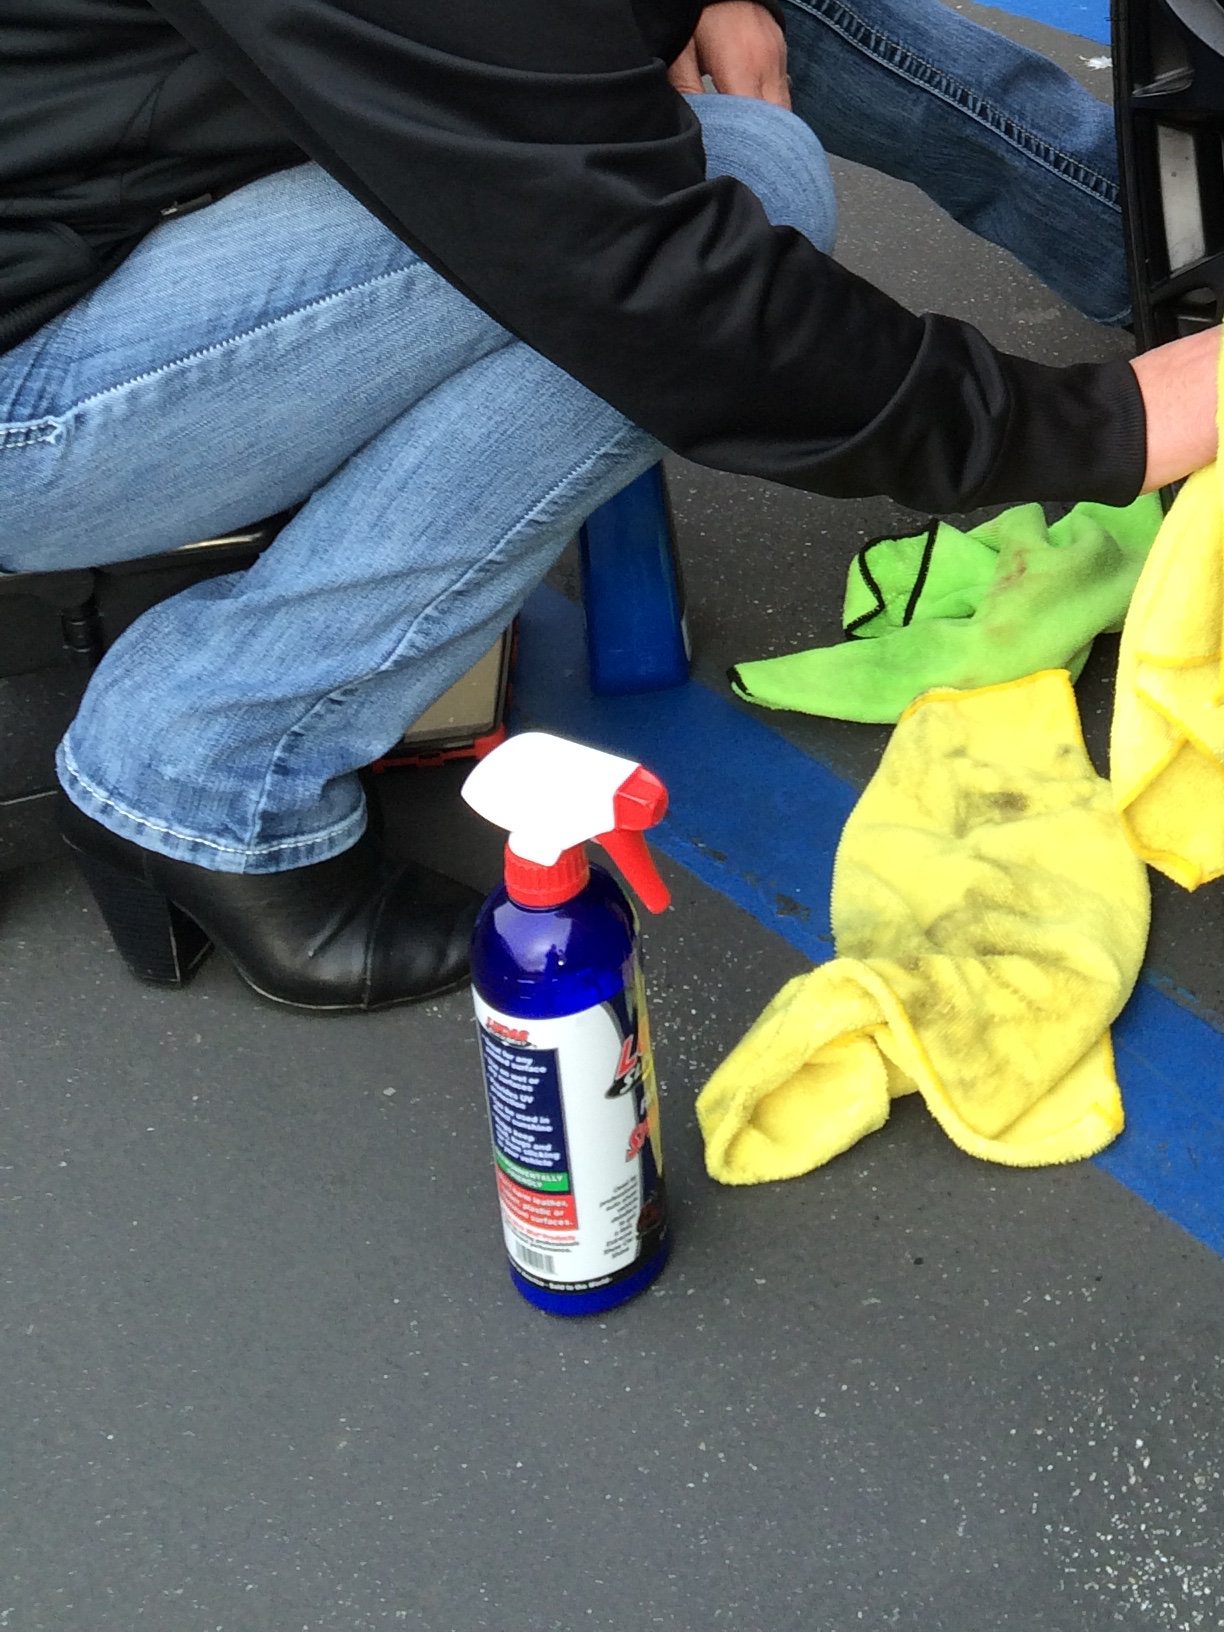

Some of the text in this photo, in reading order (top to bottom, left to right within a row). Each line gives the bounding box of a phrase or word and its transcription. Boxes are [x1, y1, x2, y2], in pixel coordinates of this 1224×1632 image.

[502, 1050, 515, 1061] for
[515, 1056, 534, 1066] any
[511, 1062, 547, 1073] surface
[498, 1074, 534, 1092] surfaces
[510, 1074, 527, 1083] wet
[528, 1077, 540, 1085] or
[519, 1094, 535, 1104] UV
[504, 1106, 515, 1117] be
[515, 1113, 538, 1123] used
[539, 1116, 551, 1124] in
[511, 1119, 554, 1132] sunshine
[513, 1129, 536, 1142] keep
[511, 1136, 532, 1148] bugs
[533, 1143, 552, 1151] and
[504, 1146, 520, 1159] your
[520, 1155, 554, 1167] vehicle
[523, 1149, 561, 1161] sticking
